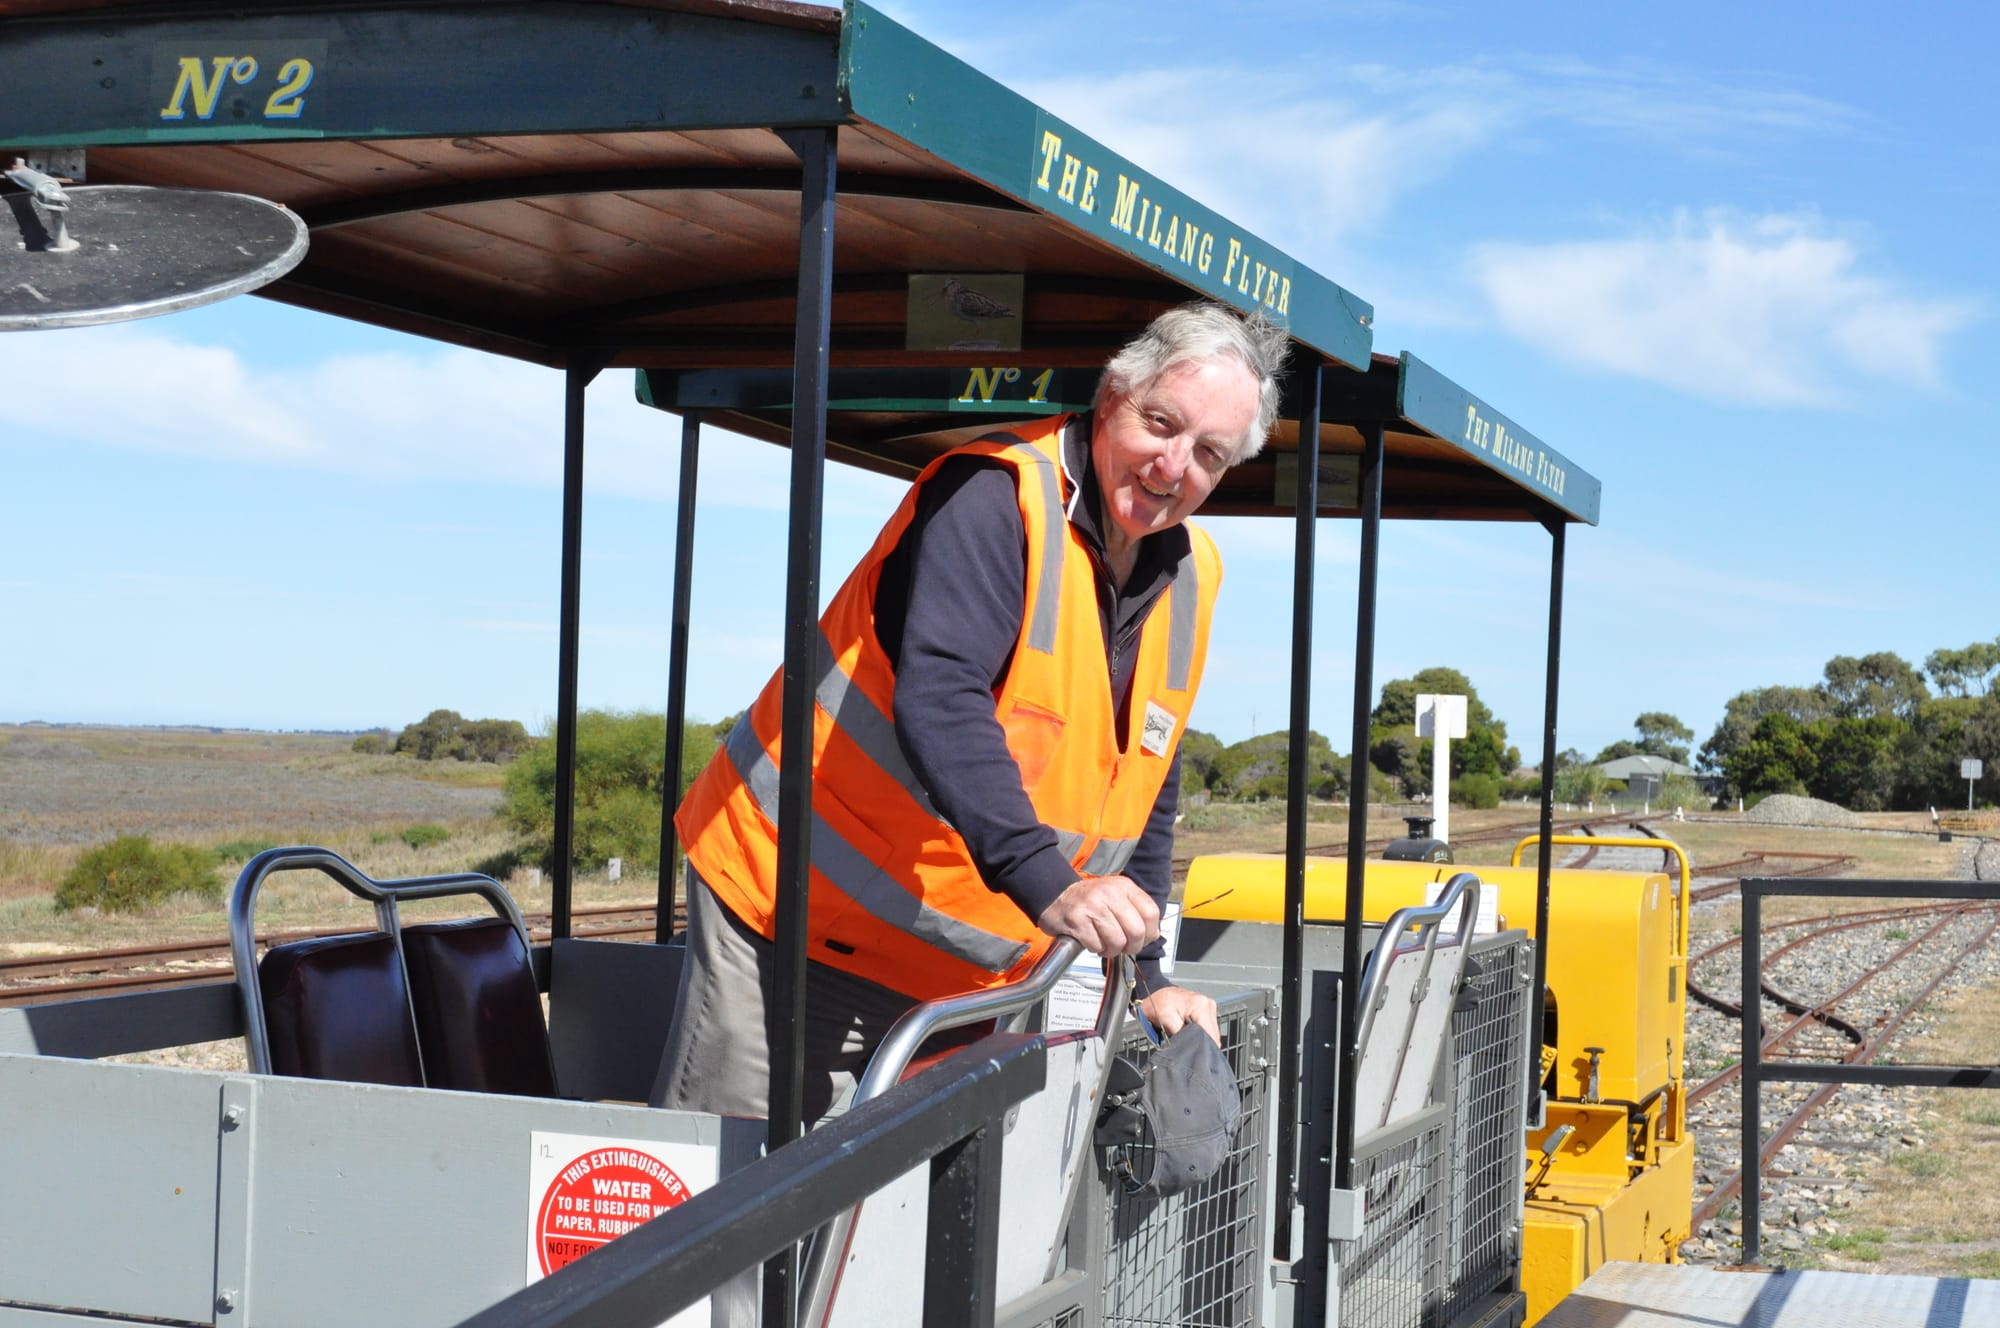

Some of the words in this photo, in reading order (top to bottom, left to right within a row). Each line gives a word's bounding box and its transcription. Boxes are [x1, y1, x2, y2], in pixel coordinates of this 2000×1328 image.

[264, 58, 314, 118] 2
[1037, 130, 1099, 215] THE
[1110, 174, 1214, 276] MILANG
[1222, 237, 1292, 316] FLYER
[1027, 368, 1054, 404] 1
[1465, 404, 1490, 450] THE
[1492, 423, 1534, 476] MILANG
[1536, 450, 1566, 496] FLYER
[562, 1158, 591, 1186] THIS
[590, 1151, 683, 1196] EXTINGUISHER
[592, 1178, 652, 1199] WATER
[556, 1214, 596, 1234] PAPER,
[557, 1196, 572, 1210] TO
[576, 1198, 590, 1212] BE
[594, 1200, 625, 1216] USED
[628, 1202, 650, 1218] FOR
[548, 1241, 570, 1255] NOT
